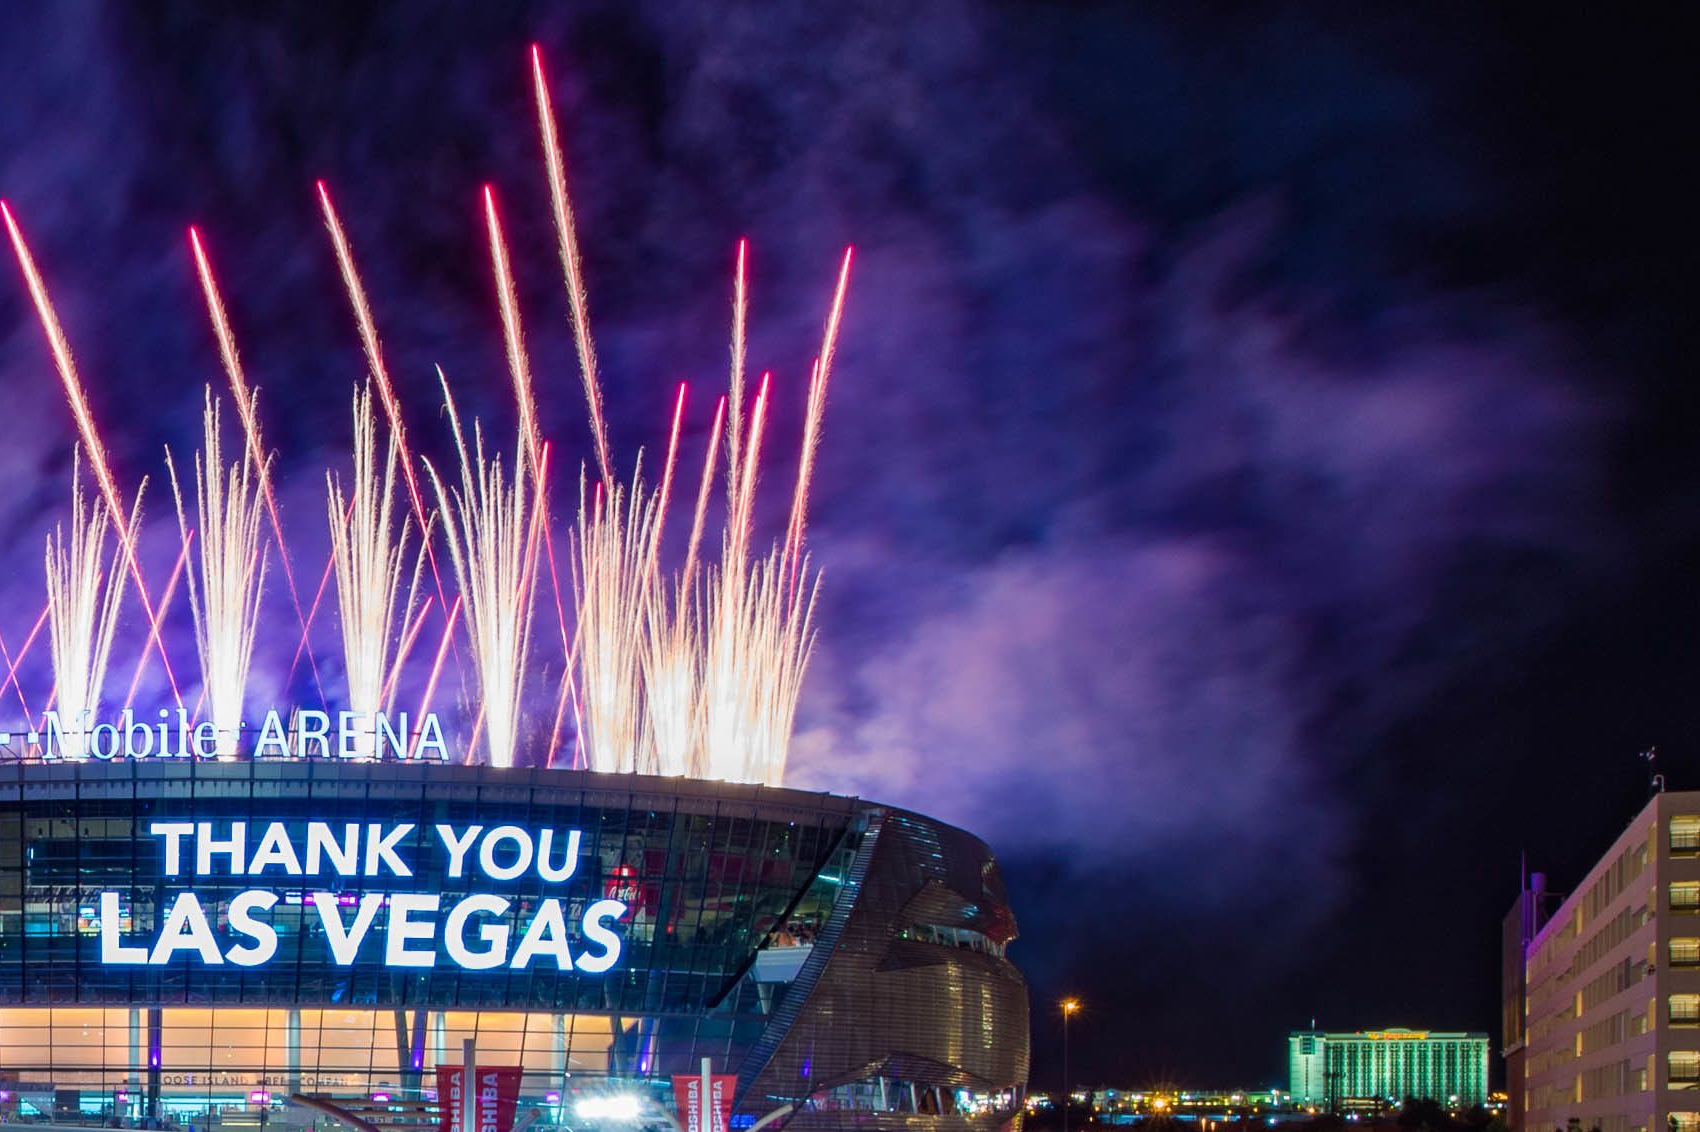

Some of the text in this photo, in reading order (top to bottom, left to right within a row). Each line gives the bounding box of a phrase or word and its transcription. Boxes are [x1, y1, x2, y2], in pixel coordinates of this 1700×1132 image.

[254, 709, 450, 761] ARENA
[150, 821, 582, 883] THANK YOU
[100, 889, 628, 974] LAS VEGAS
[202, 1076, 249, 1086] ISLAND
